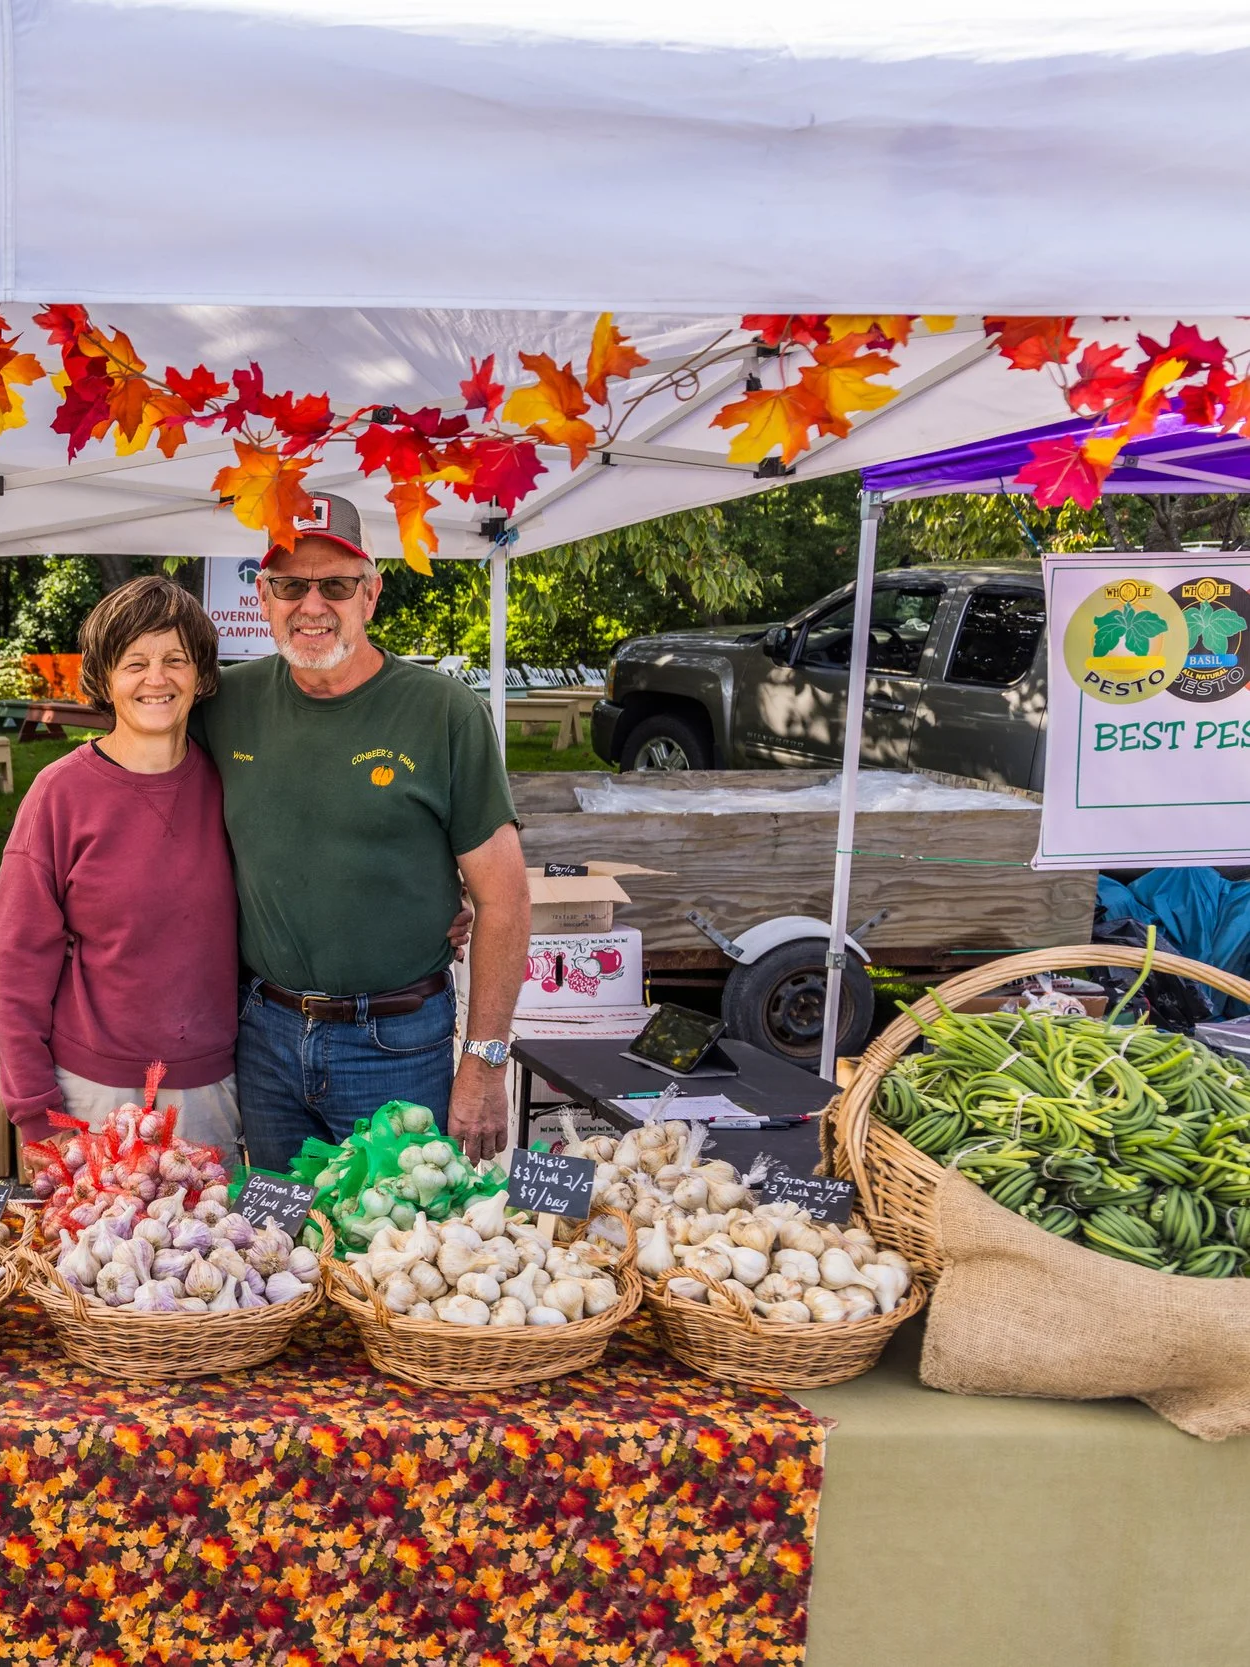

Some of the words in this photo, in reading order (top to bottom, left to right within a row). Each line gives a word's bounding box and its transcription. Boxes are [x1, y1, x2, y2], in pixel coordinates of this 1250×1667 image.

[1106, 582, 1152, 601] WHOLE
[1183, 581, 1230, 600] WHOLE
[240, 596, 258, 606] NO
[1190, 656, 1222, 665] BASIL
[1084, 670, 1166, 696] PESTO
[1182, 668, 1194, 678] ALL
[1196, 668, 1228, 680] NATURAL
[1094, 720, 1185, 751] BEST
[232, 750, 254, 762] Wayne
[351, 748, 394, 765] CONBEER'S
[398, 753, 416, 773] FARM
[527, 1152, 570, 1169] Music
[248, 1176, 288, 1196] German
[290, 1184, 314, 1201] Red
[563, 1172, 594, 1192] 2/5
[772, 1172, 822, 1188] German
[520, 1184, 569, 1213] $9/bag
[814, 1192, 846, 1204] 2/5
[282, 1204, 306, 1218] 2/5
